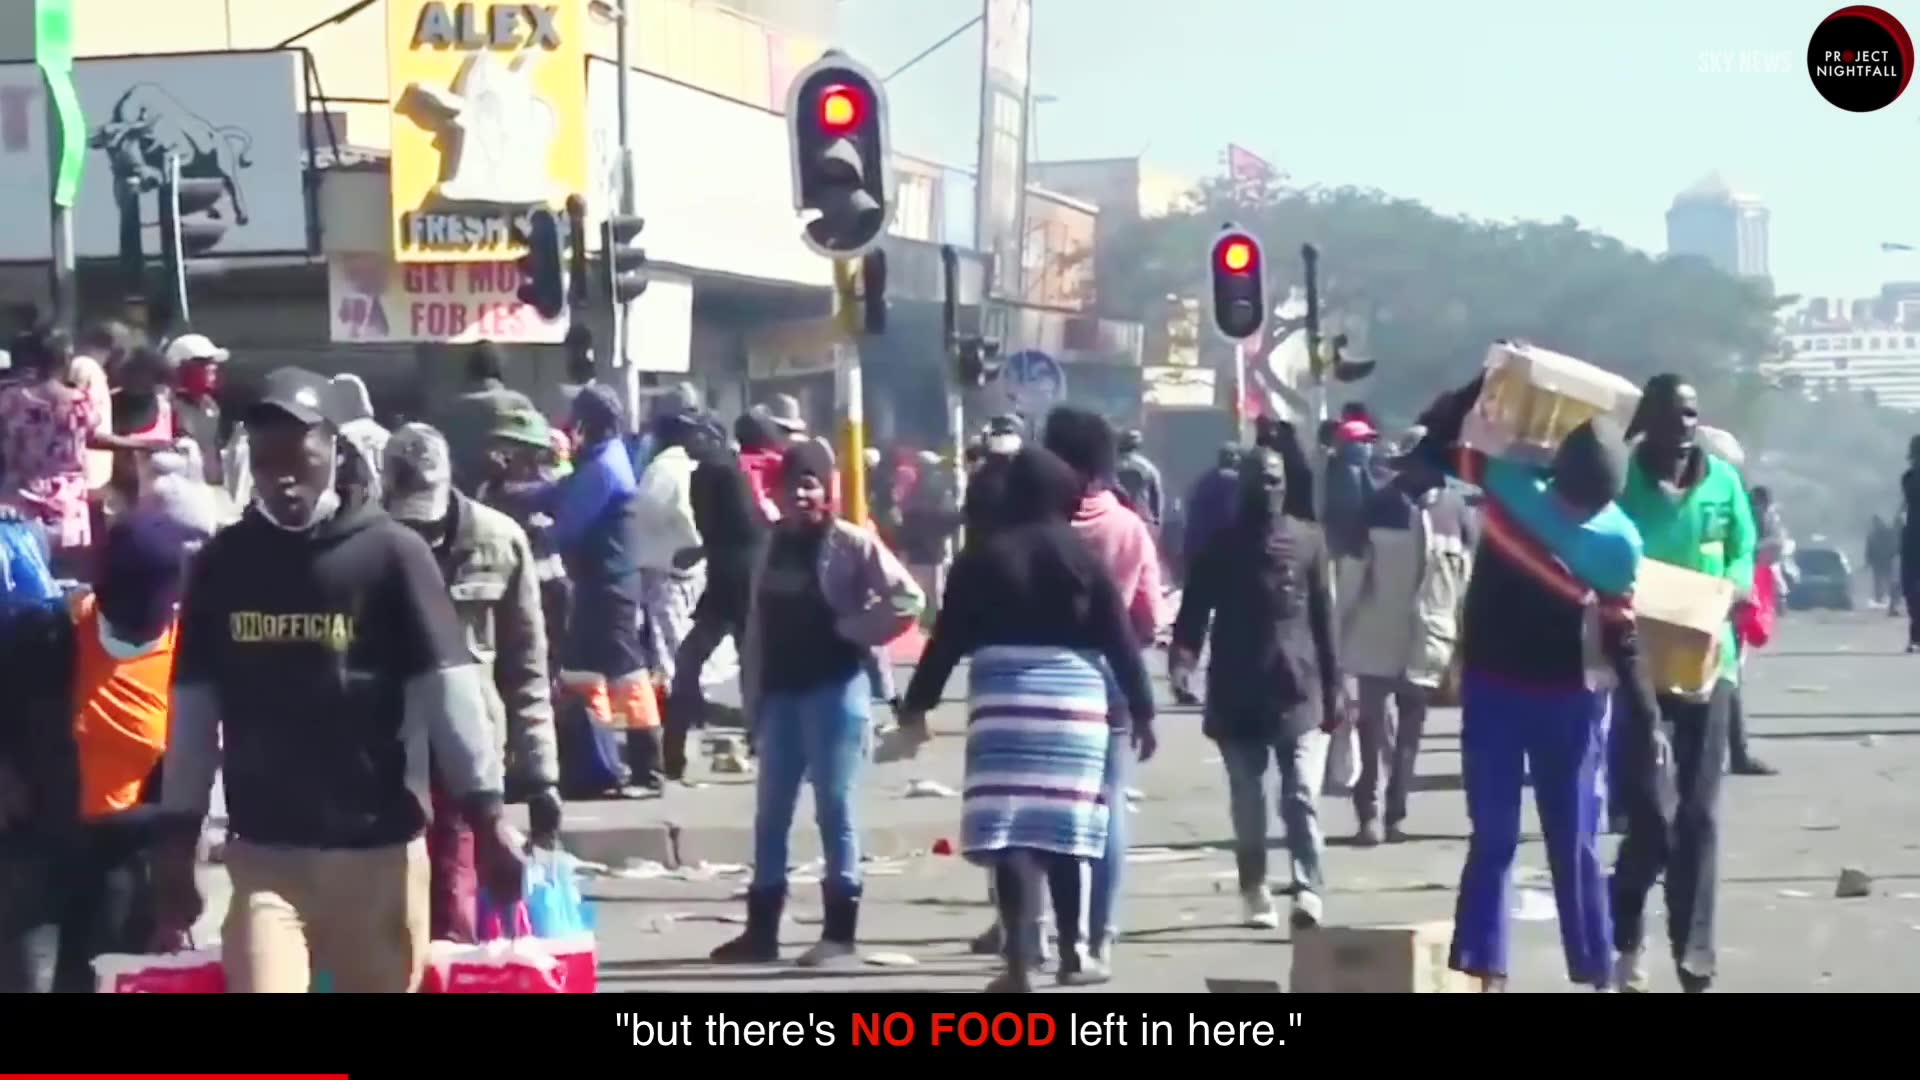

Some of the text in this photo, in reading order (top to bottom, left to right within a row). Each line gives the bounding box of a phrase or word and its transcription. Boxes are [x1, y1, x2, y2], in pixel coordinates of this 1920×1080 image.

[409, 1, 562, 51] ALEX
[406, 212, 510, 248] FRESH
[229, 611, 355, 643] UNOFFICIAL
